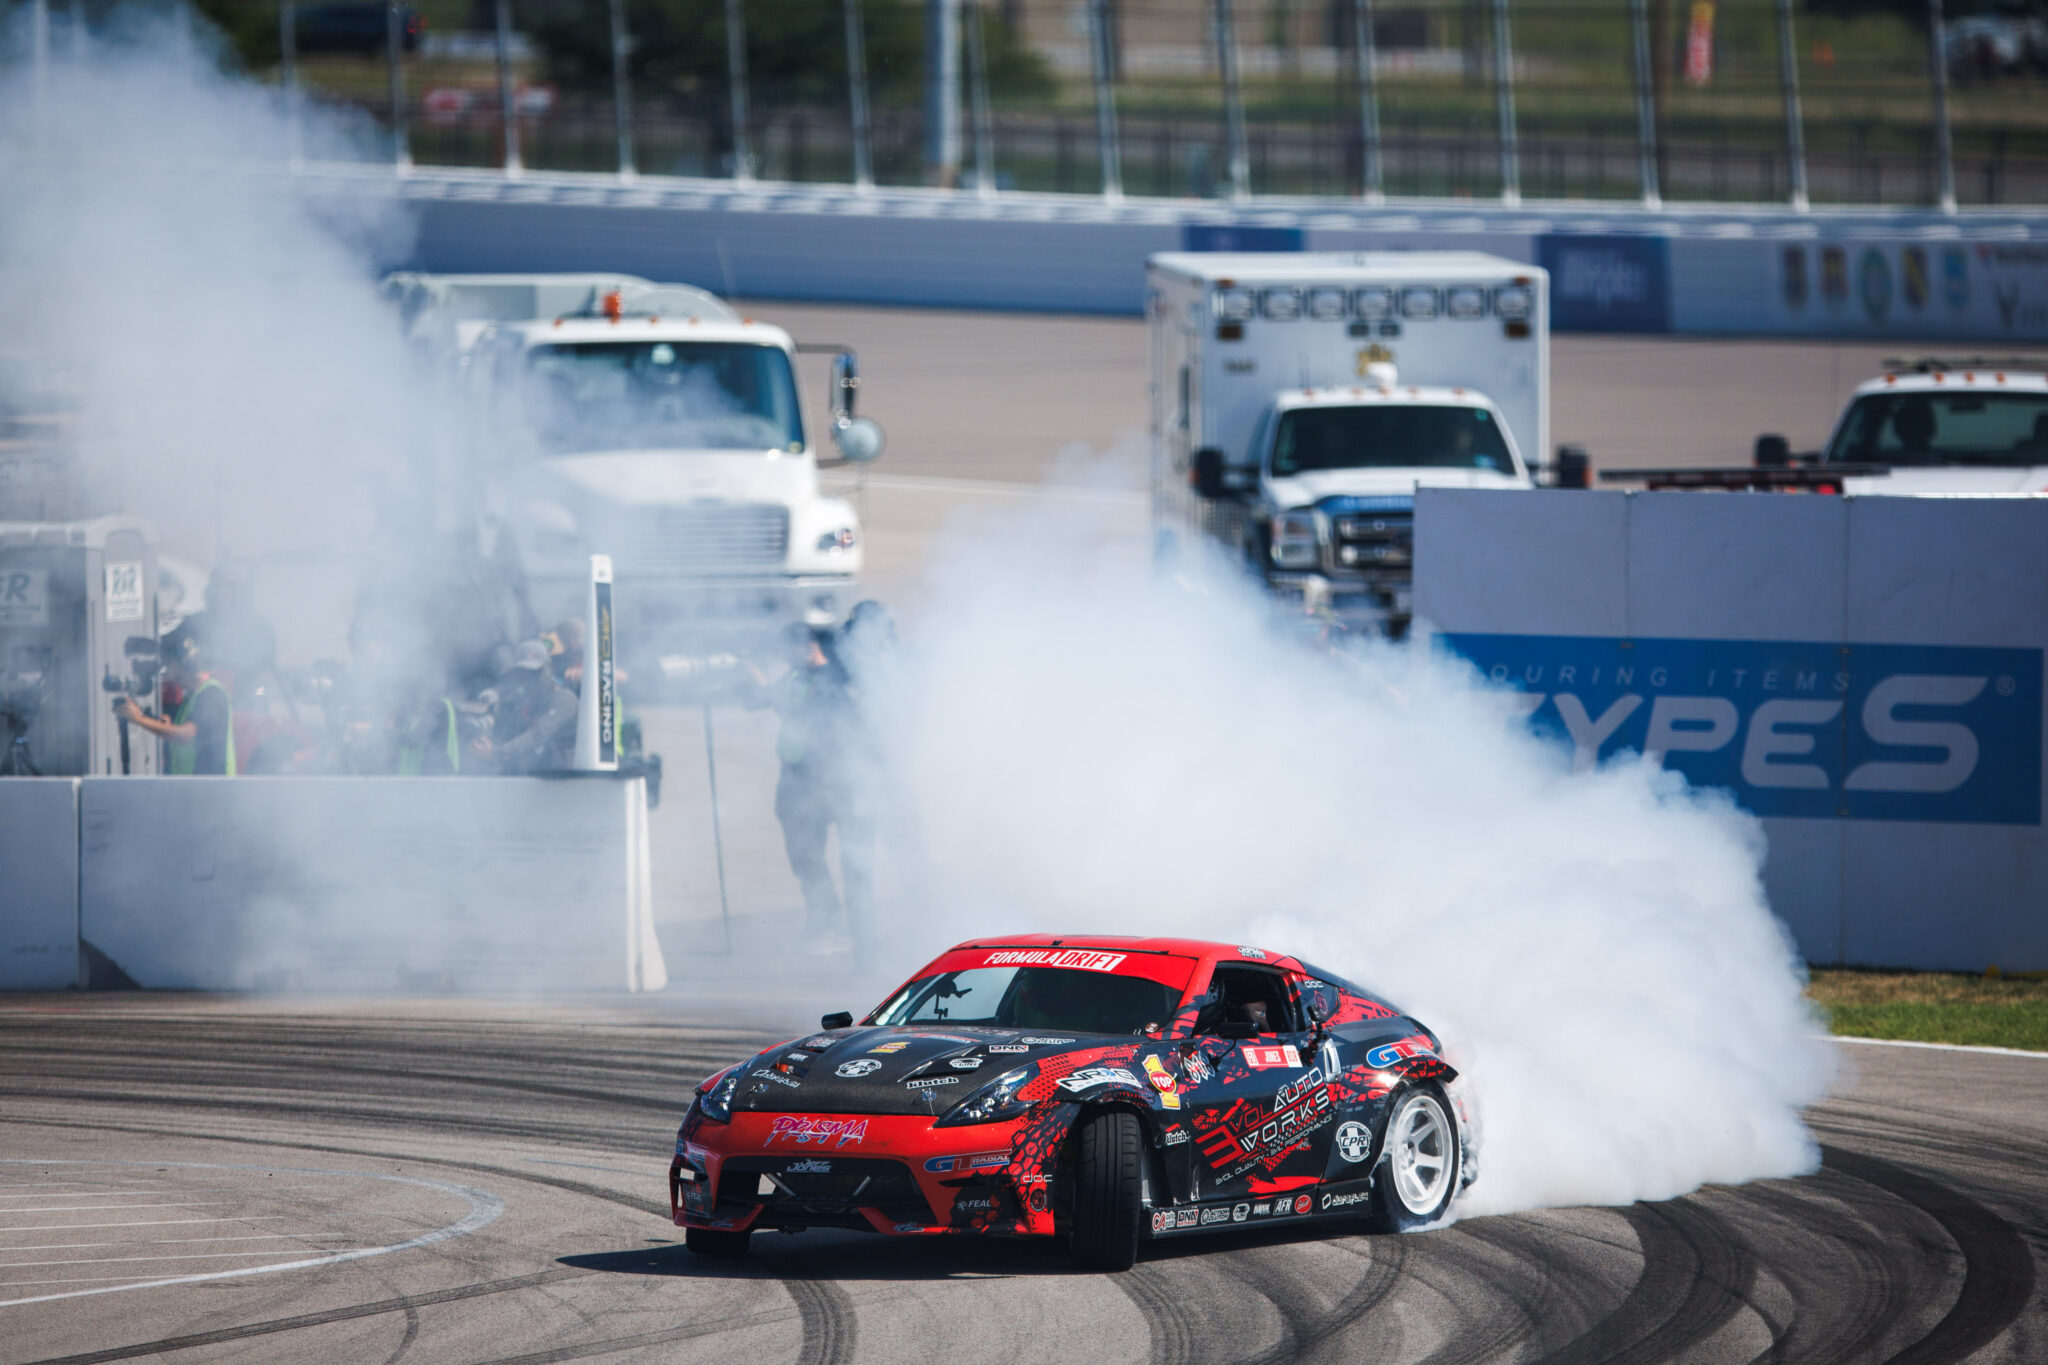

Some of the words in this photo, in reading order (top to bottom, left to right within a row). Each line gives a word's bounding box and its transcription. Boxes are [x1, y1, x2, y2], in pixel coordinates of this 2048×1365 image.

[1490, 664, 1668, 687] OURING
[1707, 669, 1851, 692] ITEMS
[1500, 674, 1988, 793] YPES
[1152, 1076, 1173, 1088] TOP
[1273, 1067, 1323, 1113] AUTO
[1240, 1088, 1329, 1152] WORKS
[1284, 1113, 1333, 1147] PERFORMANCE
[1342, 1136, 1366, 1147] CPR
[924, 1149, 1012, 1173] GT
[972, 1155, 1010, 1164] RADIAL
[1022, 1173, 1053, 1183] doc
[968, 1200, 992, 1208] FEAL
[1275, 1199, 1292, 1213] AFR
[1178, 1210, 1198, 1221] DNA
